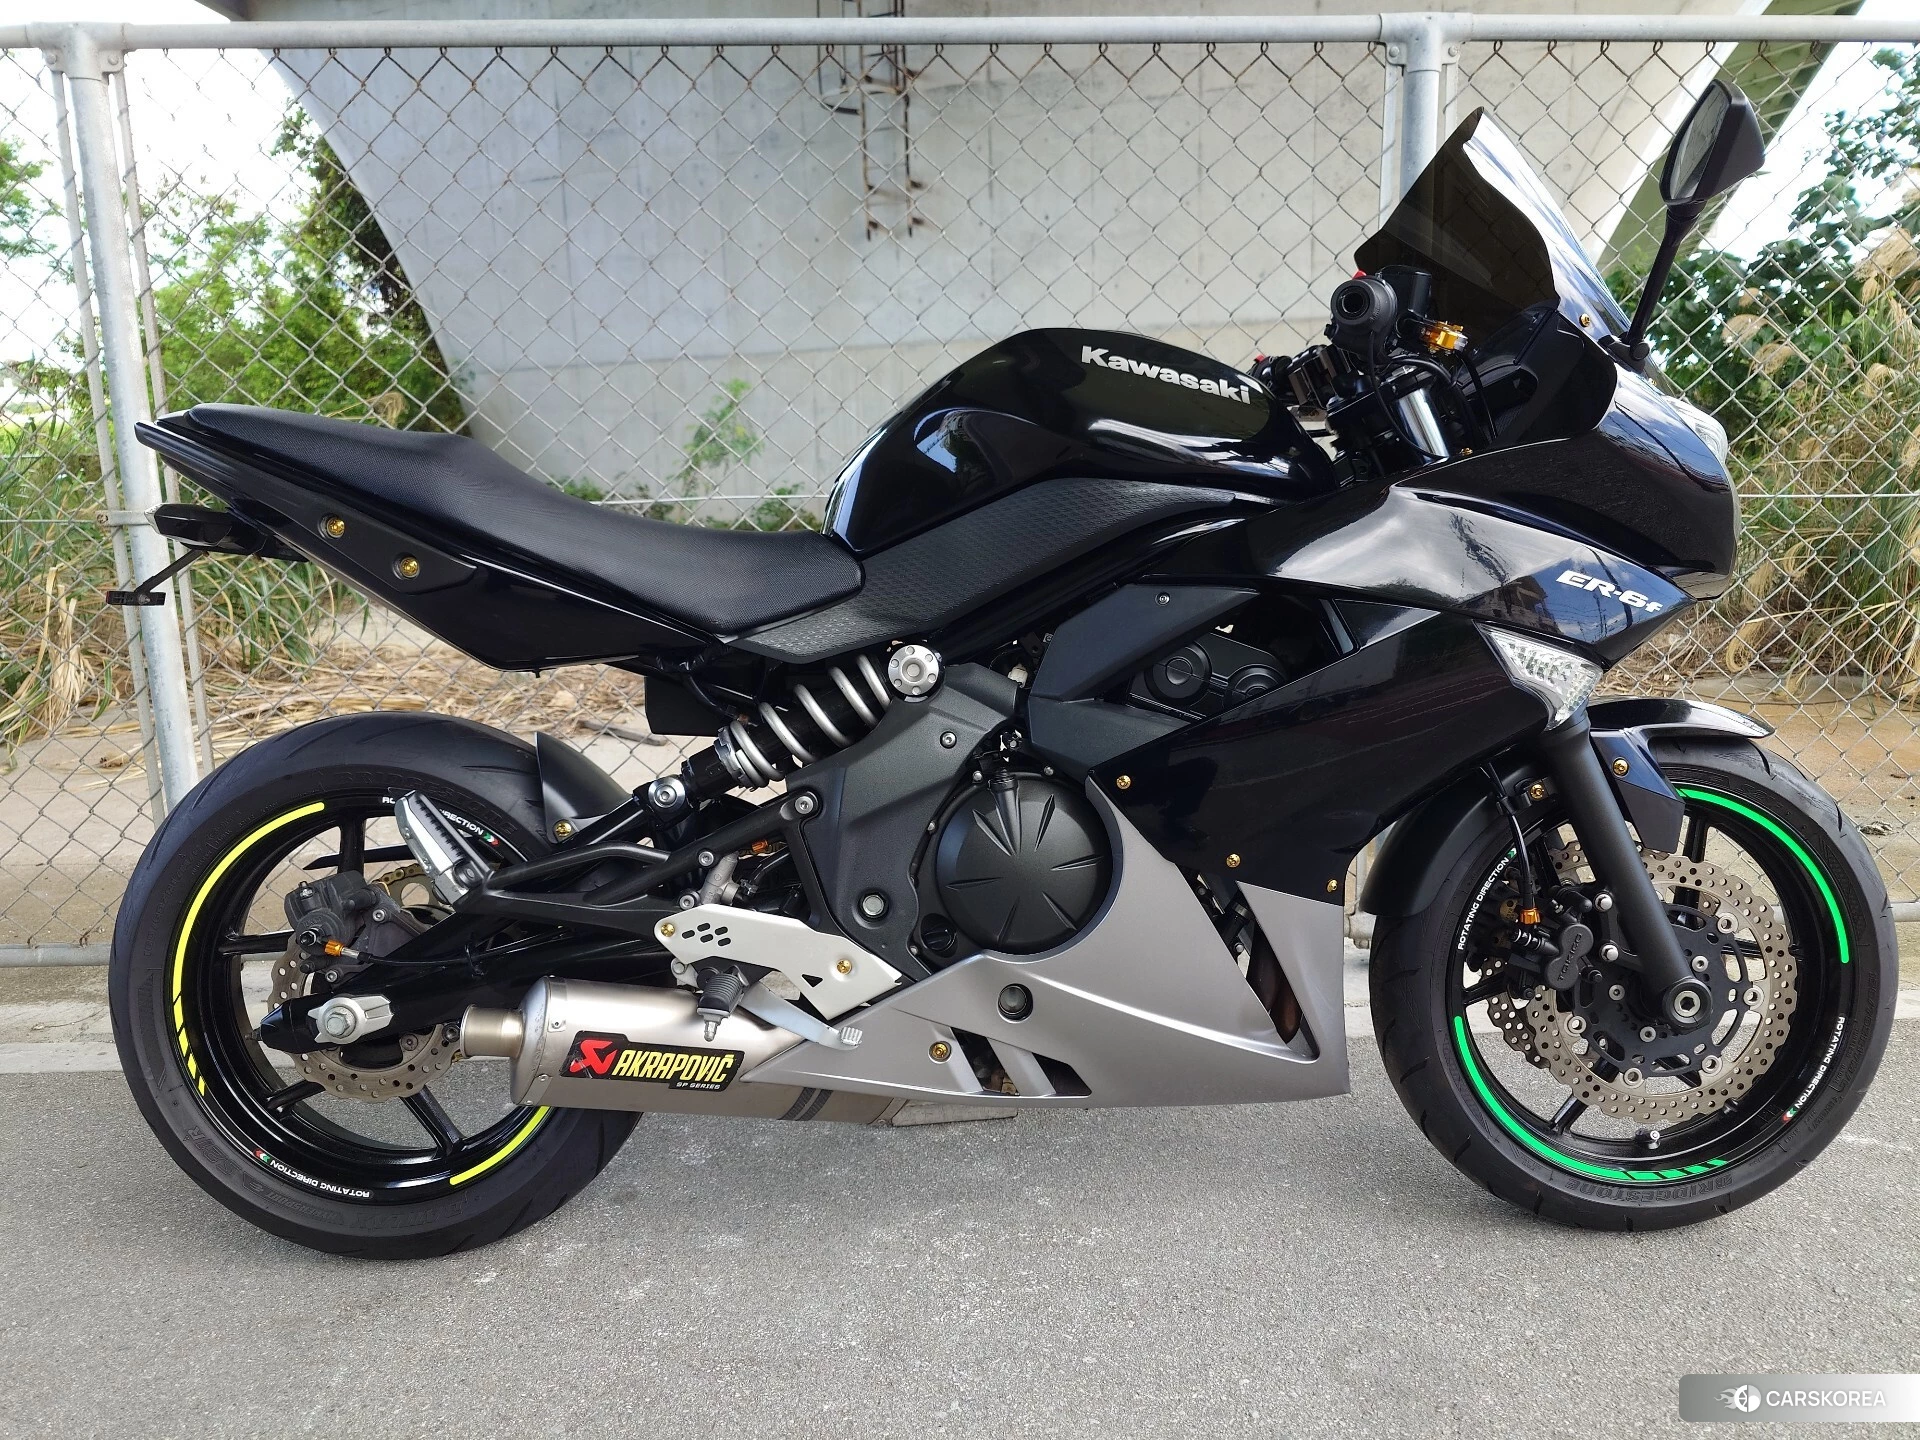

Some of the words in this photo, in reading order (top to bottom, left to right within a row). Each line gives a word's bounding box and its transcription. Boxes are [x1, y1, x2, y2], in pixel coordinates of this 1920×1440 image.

[1081, 345, 1251, 405] Kawasaki
[1555, 569, 1664, 613] ER-6f
[1457, 903, 1480, 950] ROTATING
[1476, 857, 1509, 902] DIRECTION
[1823, 1016, 1846, 1064] ROTATING
[1794, 1064, 1827, 1109] DIRECTION
[269, 1159, 319, 1187] DIRECTION
[320, 1182, 370, 1198] ROTATING
